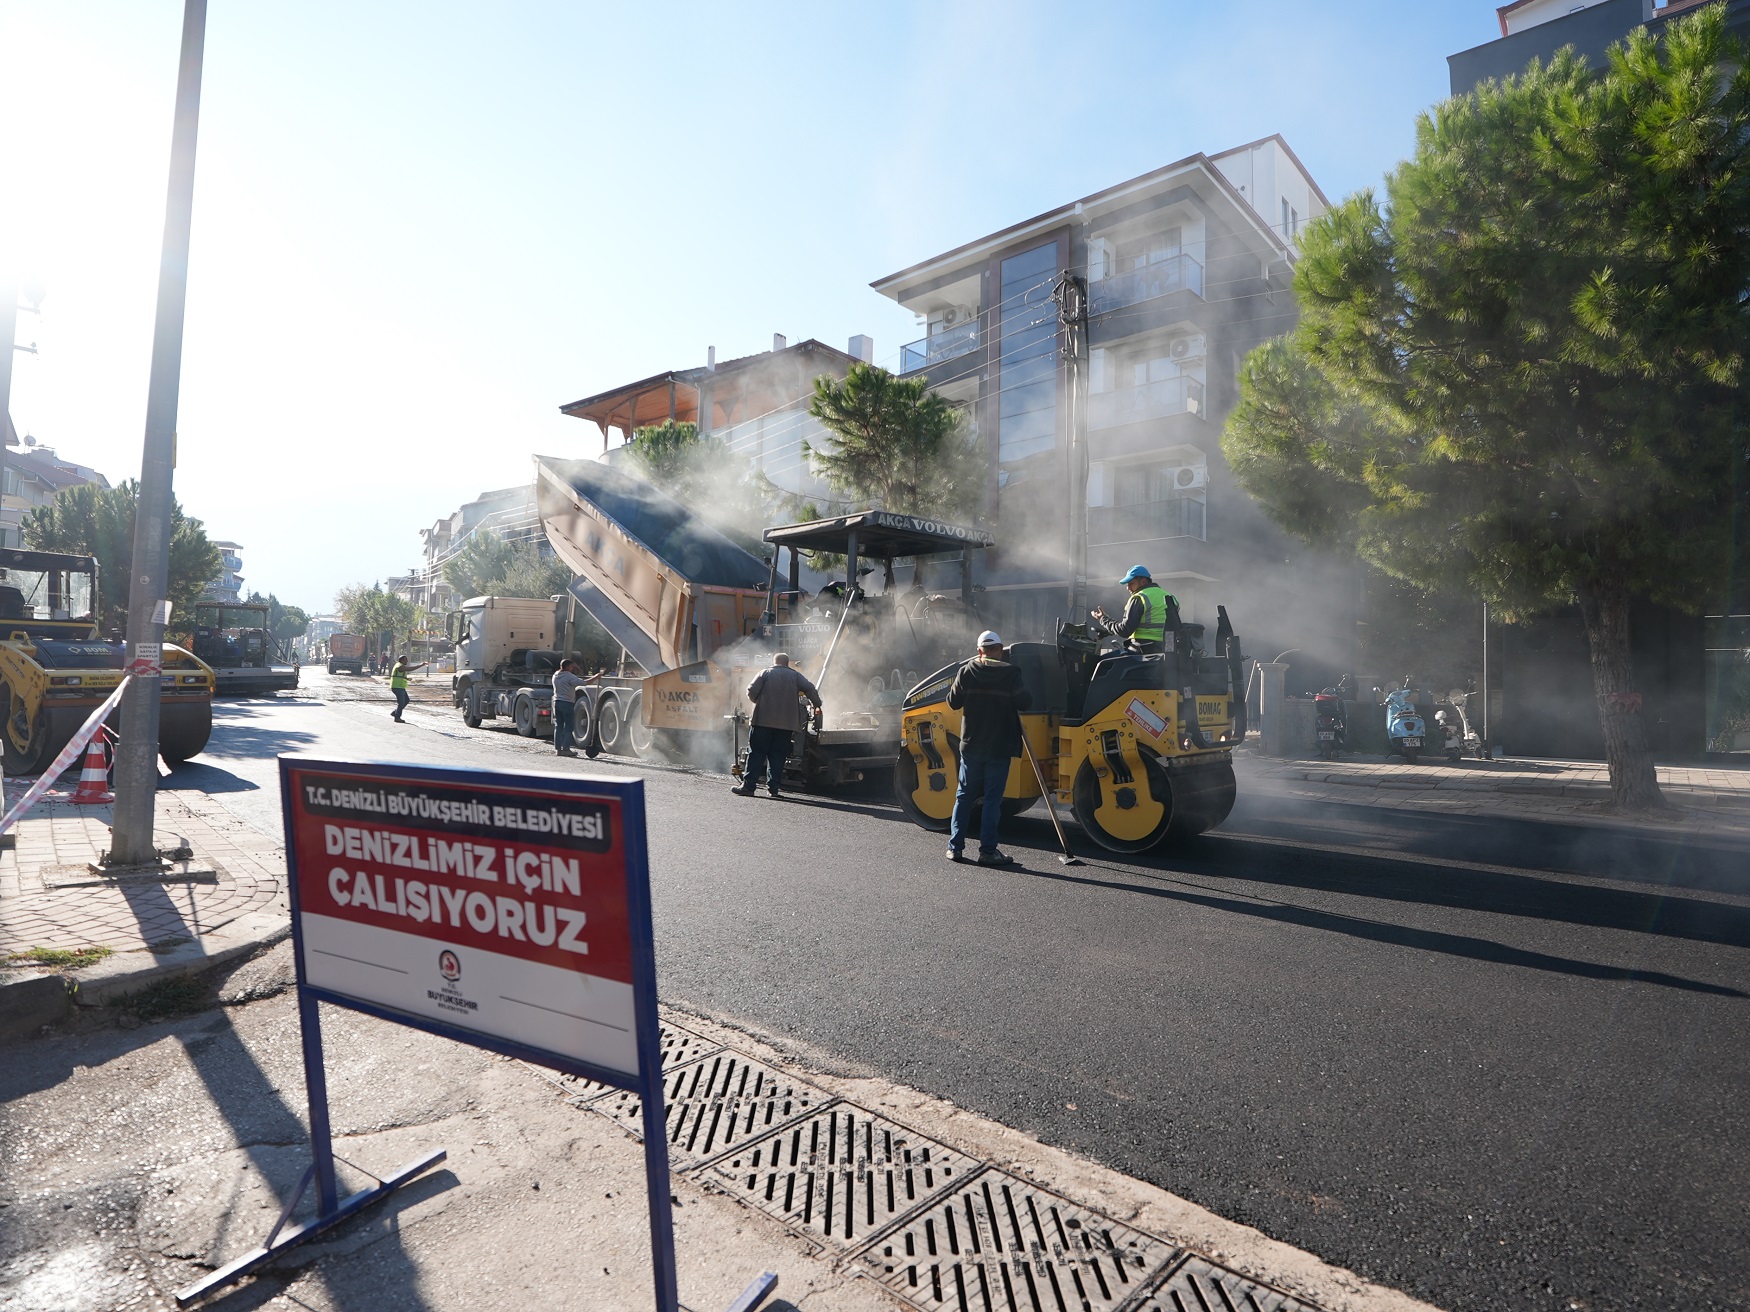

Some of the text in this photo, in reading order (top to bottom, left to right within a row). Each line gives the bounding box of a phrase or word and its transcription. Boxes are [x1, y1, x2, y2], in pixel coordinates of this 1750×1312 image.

[878, 514, 995, 547] AKÇA VOLVO AKÇA
[665, 704, 699, 713] ASFALT
[668, 691, 699, 704] AKÇA
[1199, 702, 1221, 715] BOMAG
[306, 786, 604, 840] T.C. DENİZLİ BÜYÜKŞEHİR BELEDİYESİ
[324, 823, 498, 882] DENİZLİMİZ
[328, 867, 589, 955] ÇALIŞIYORUZ
